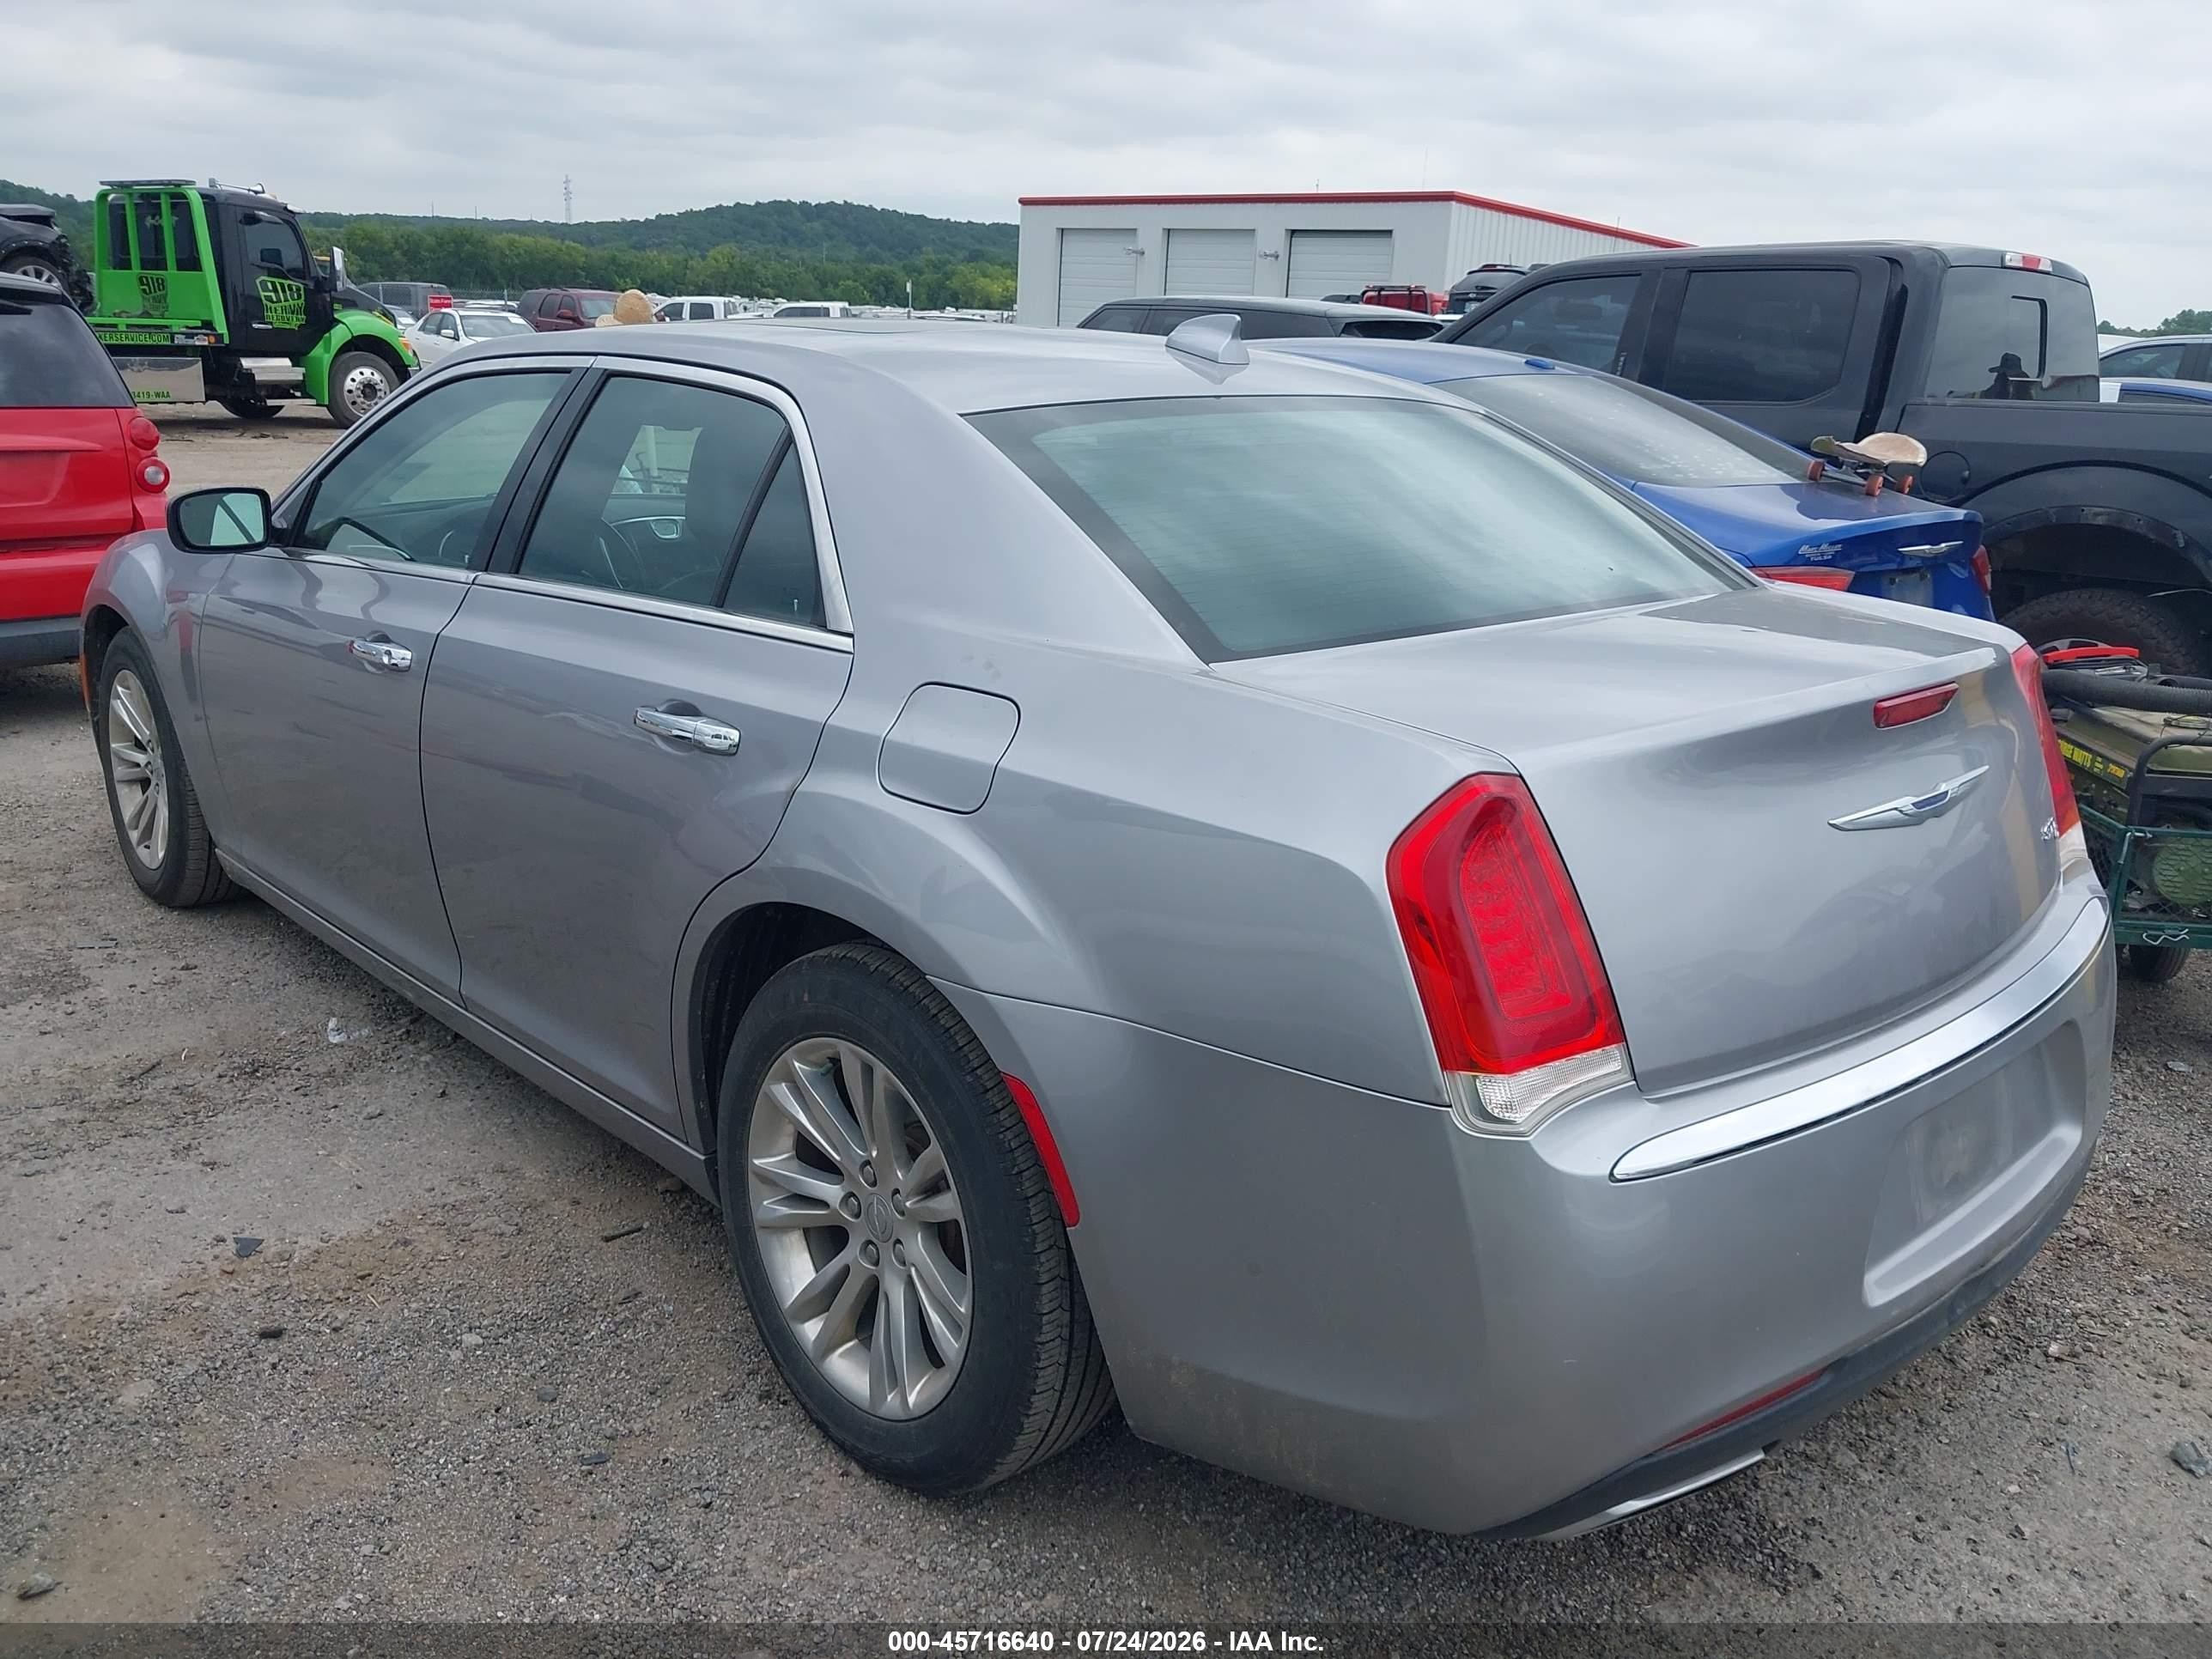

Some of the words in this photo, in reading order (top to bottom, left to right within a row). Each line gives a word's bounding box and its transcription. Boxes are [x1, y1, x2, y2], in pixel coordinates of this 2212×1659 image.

[138, 276, 166, 295] 918
[258, 279, 303, 304] 918
[264, 302, 304, 317] HEAVY
